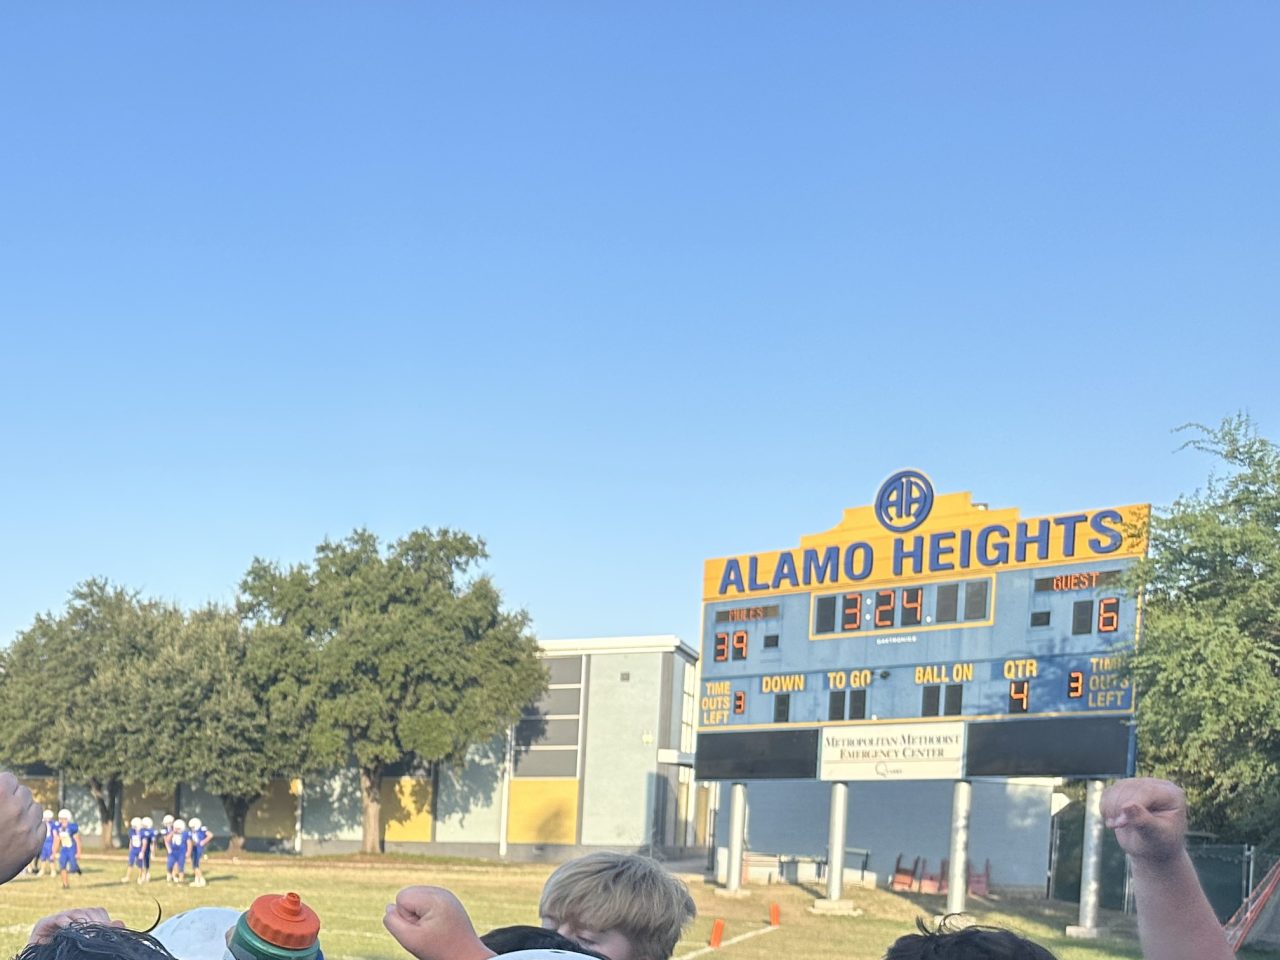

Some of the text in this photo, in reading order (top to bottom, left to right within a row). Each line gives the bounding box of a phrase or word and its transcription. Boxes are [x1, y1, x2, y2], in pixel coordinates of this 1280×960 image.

[719, 509, 1124, 595] ALAMO HEIGHTS
[1053, 571, 1100, 591] GUEST
[843, 588, 922, 630] 3:24
[1099, 597, 1118, 632] 6
[715, 630, 748, 662] 39
[827, 670, 871, 689] TO GO
[915, 663, 974, 684] BALL ON
[1004, 659, 1038, 680] QTR
[705, 681, 732, 695] TIME
[762, 674, 805, 693] DOWN
[1069, 672, 1083, 697] 3
[701, 696, 730, 710] OUTS
[735, 691, 745, 714] 3
[1010, 681, 1028, 710] 4
[1088, 691, 1126, 707] LEFT
[703, 711, 730, 725] LEFT
